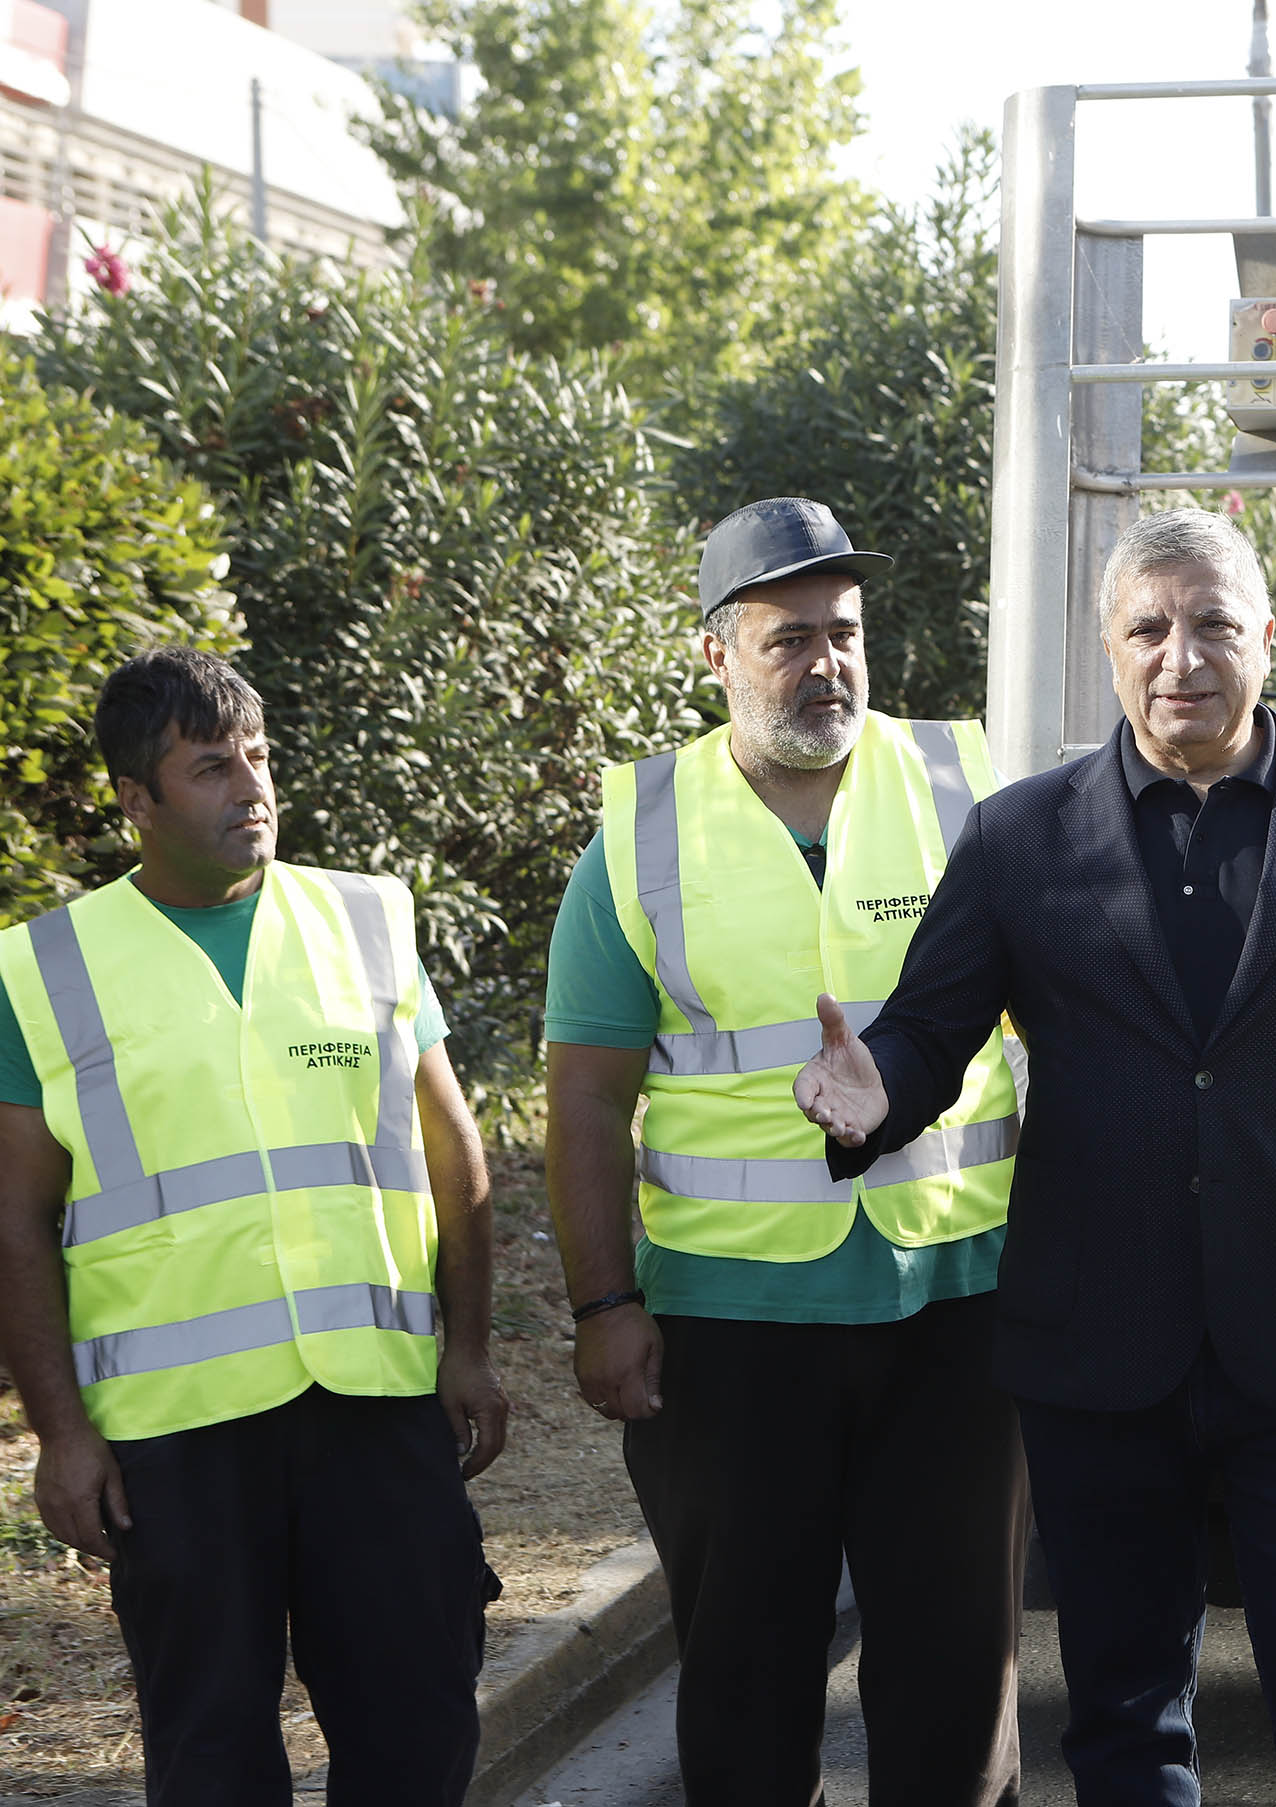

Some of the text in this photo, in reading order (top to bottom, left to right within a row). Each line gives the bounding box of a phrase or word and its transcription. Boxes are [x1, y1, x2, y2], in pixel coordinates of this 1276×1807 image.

[856, 894, 931, 910] ΠΕΡΙΦΕΡΕΙ
[288, 1042, 372, 1057] ΠΕΡΙΦΕΡΕΙΑ
[306, 1055, 361, 1068] ΑΤΤΙΚΗΣ
